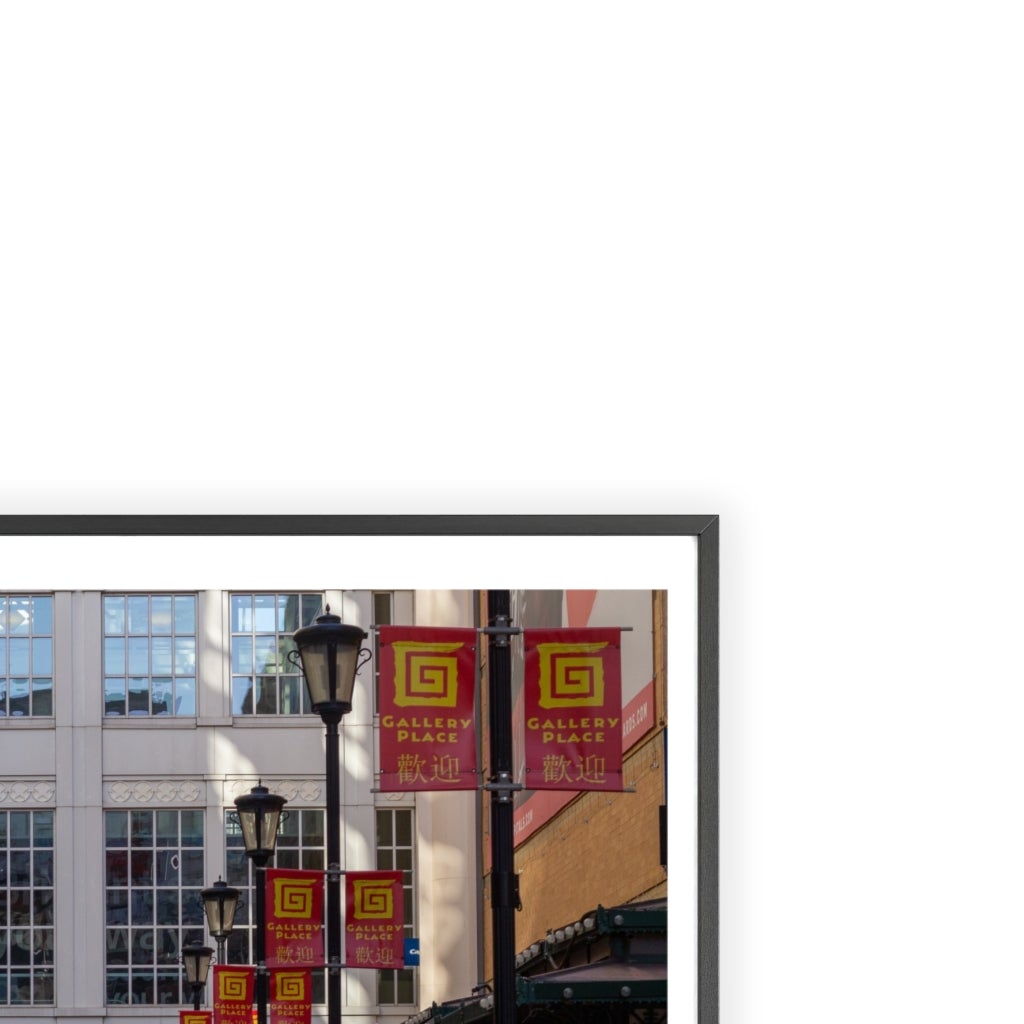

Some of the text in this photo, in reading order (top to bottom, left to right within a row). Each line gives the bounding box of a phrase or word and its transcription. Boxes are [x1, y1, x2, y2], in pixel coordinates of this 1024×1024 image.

[382, 716, 472, 728] GALLERY
[527, 718, 620, 730] GALLERY
[397, 730, 458, 742] PLACE
[543, 732, 605, 744] PLACE
[397, 754, 462, 784] 歡迎
[543, 754, 607, 784] 歡迎
[267, 922, 320, 931] GALLERY
[347, 924, 402, 932] GALLERY
[276, 932, 312, 940] PLACE
[276, 946, 314, 964] 歡迎
[356, 946, 394, 965] 歡迎
